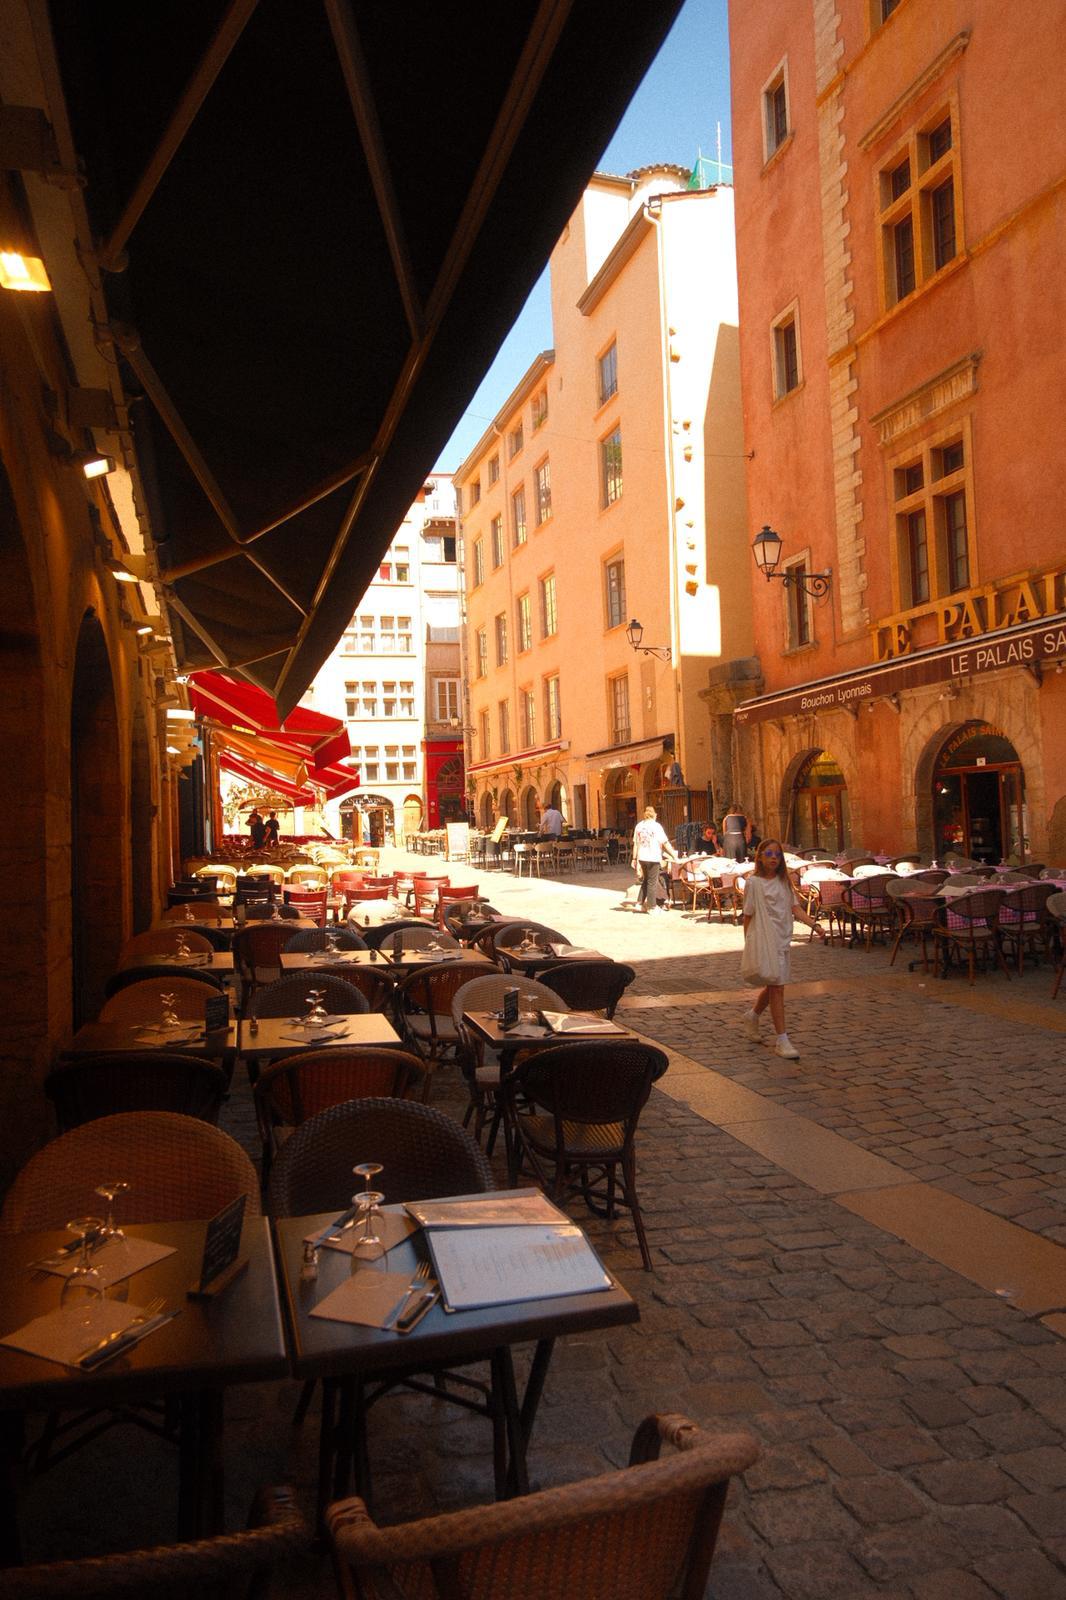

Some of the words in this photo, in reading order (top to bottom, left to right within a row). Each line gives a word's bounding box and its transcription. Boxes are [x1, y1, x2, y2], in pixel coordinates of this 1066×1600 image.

[870, 620, 912, 662] LE
[936, 572, 1066, 646] PALAI
[951, 654, 969, 675] LE
[976, 639, 1034, 669] PALAIS
[801, 693, 834, 710] Bouchon
[838, 683, 872, 703] Lyonnais
